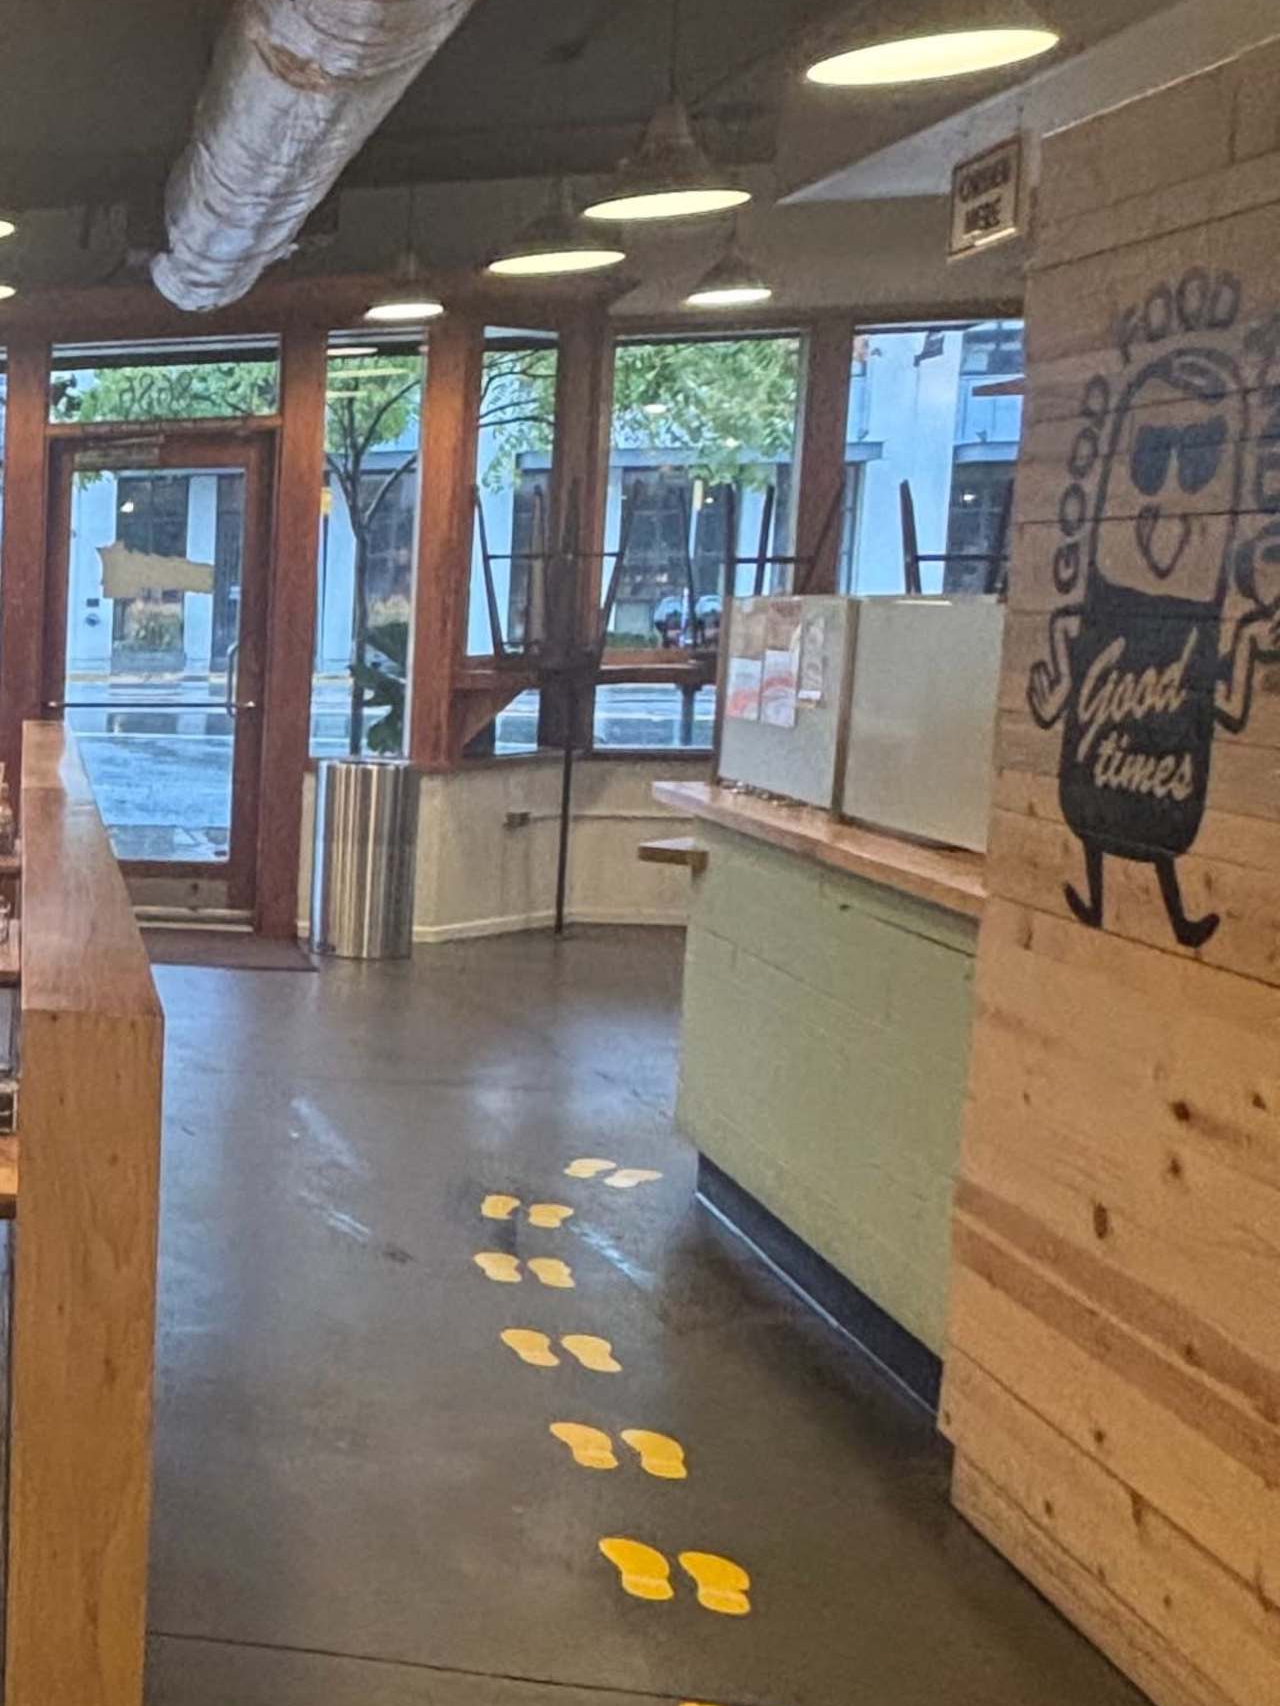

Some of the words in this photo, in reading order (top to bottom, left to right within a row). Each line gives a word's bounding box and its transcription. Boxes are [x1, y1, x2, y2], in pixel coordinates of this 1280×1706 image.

[963, 194, 1002, 234] HERE
[1052, 374, 1109, 594] GOOD
[1114, 266, 1240, 364] FOOD
[1077, 627, 1199, 762] Good
[1093, 730, 1195, 801] times
